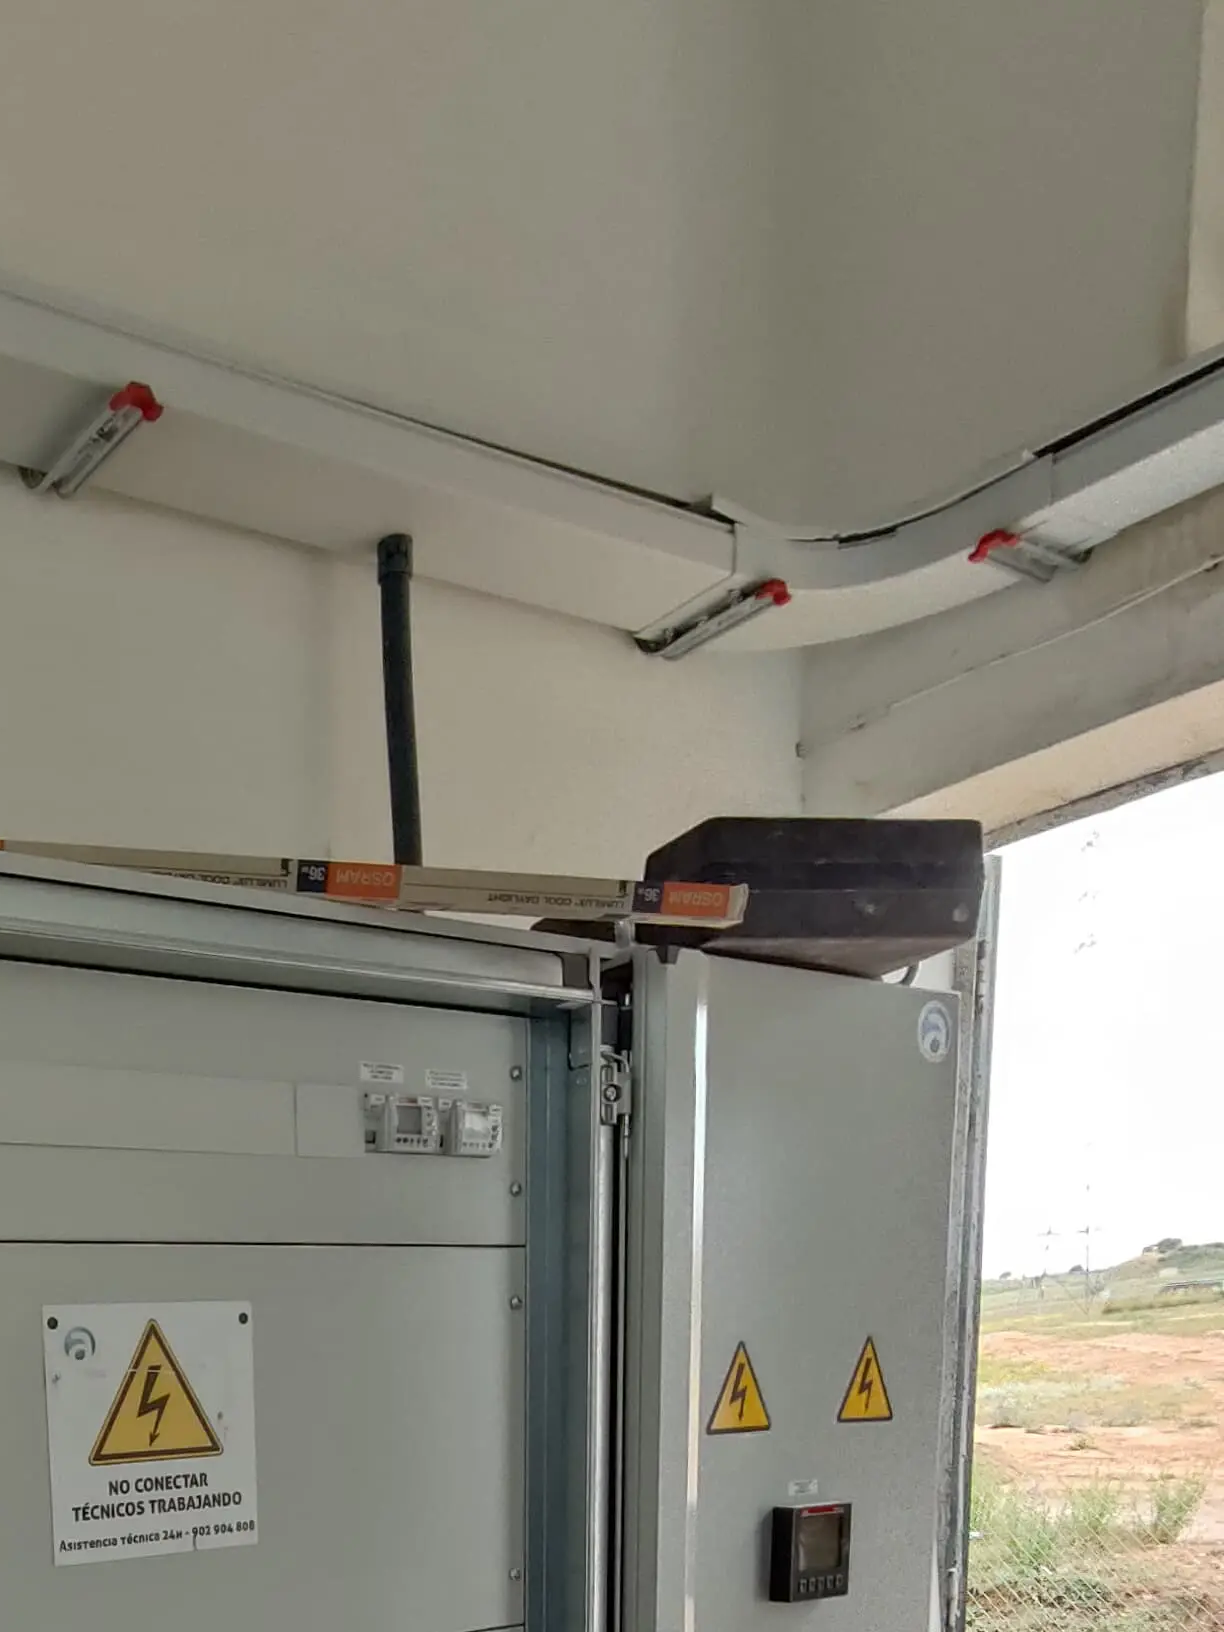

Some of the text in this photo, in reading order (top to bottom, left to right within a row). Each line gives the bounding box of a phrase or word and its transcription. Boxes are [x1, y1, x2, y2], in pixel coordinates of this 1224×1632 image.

[335, 869, 394, 887] OSRAM
[488, 892, 540, 905] DAYLIGHT
[544, 896, 573, 907] COOL
[669, 889, 724, 906] OSRAM
[109, 1472, 208, 1496] NO CONECTAR
[72, 1491, 242, 1522] TÉCNICOS TRABAJANDO
[192, 1525, 211, 1537] 902
[213, 1523, 233, 1535] 904
